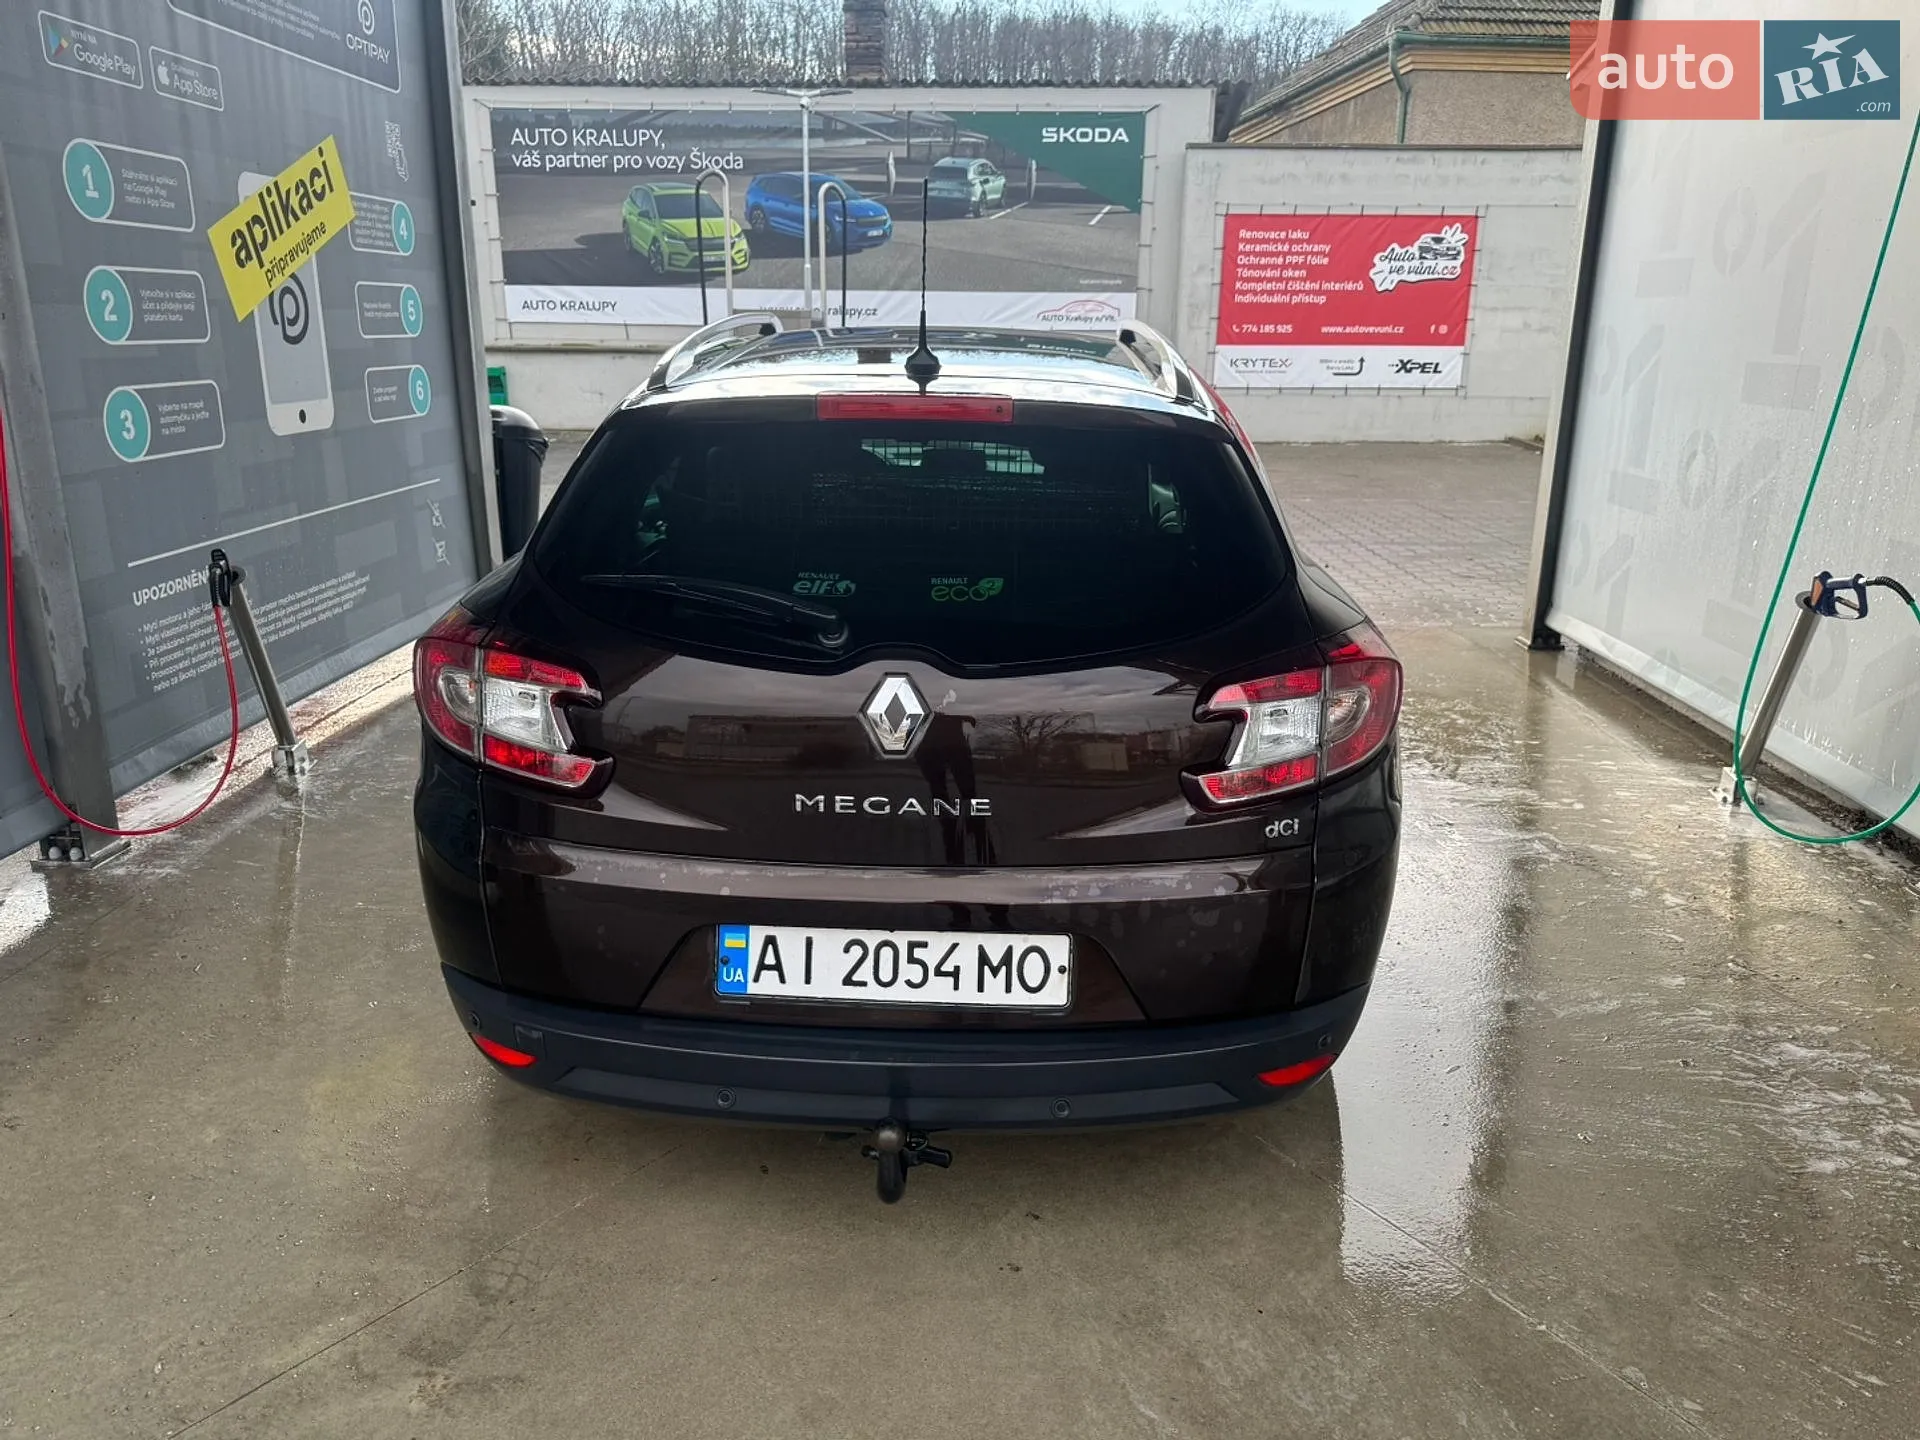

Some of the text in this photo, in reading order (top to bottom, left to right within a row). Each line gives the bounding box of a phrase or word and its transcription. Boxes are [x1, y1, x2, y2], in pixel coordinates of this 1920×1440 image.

[346, 33, 390, 64] OPTIPAY
[73, 43, 136, 80] Google Play
[173, 74, 218, 100] App Store
[510, 127, 666, 150] AUTO KRALUPY,
[512, 147, 743, 173] váš partner pro vozy Škoda
[82, 164, 99, 198] 1
[230, 146, 334, 269] aplikaci
[400, 218, 408, 240] 4
[1239, 229, 1310, 239] Renovace laku
[264, 221, 327, 288] připravujeme
[1238, 242, 1331, 254] Keramické ochrany
[1379, 247, 1416, 264] Auto
[1237, 255, 1329, 265] Ochranné PPF fólie
[1236, 268, 1307, 278] Tónování oken
[1389, 262, 1458, 276] ve vůni.cz
[1235, 280, 1364, 292] Kompletní čištění interiérů
[101, 289, 118, 321] 2
[522, 300, 617, 312] AUTO KRALUPY
[1234, 293, 1326, 305] Individuální přístup
[407, 300, 416, 321] 5
[1242, 324, 1258, 334] 774
[1276, 324, 1293, 334] 925
[1320, 325, 1405, 334] www.autovevuni.cz
[1230, 358, 1290, 368] KRYTEX
[1394, 359, 1443, 374] XPEL
[415, 380, 424, 401] 6
[120, 409, 136, 440] 3
[792, 580, 832, 595] elf
[931, 577, 969, 585] RENAULT
[795, 793, 992, 816] MEGANE
[723, 967, 745, 983] UA
[841, 939, 961, 992] 2054
[977, 944, 1052, 994] MO
